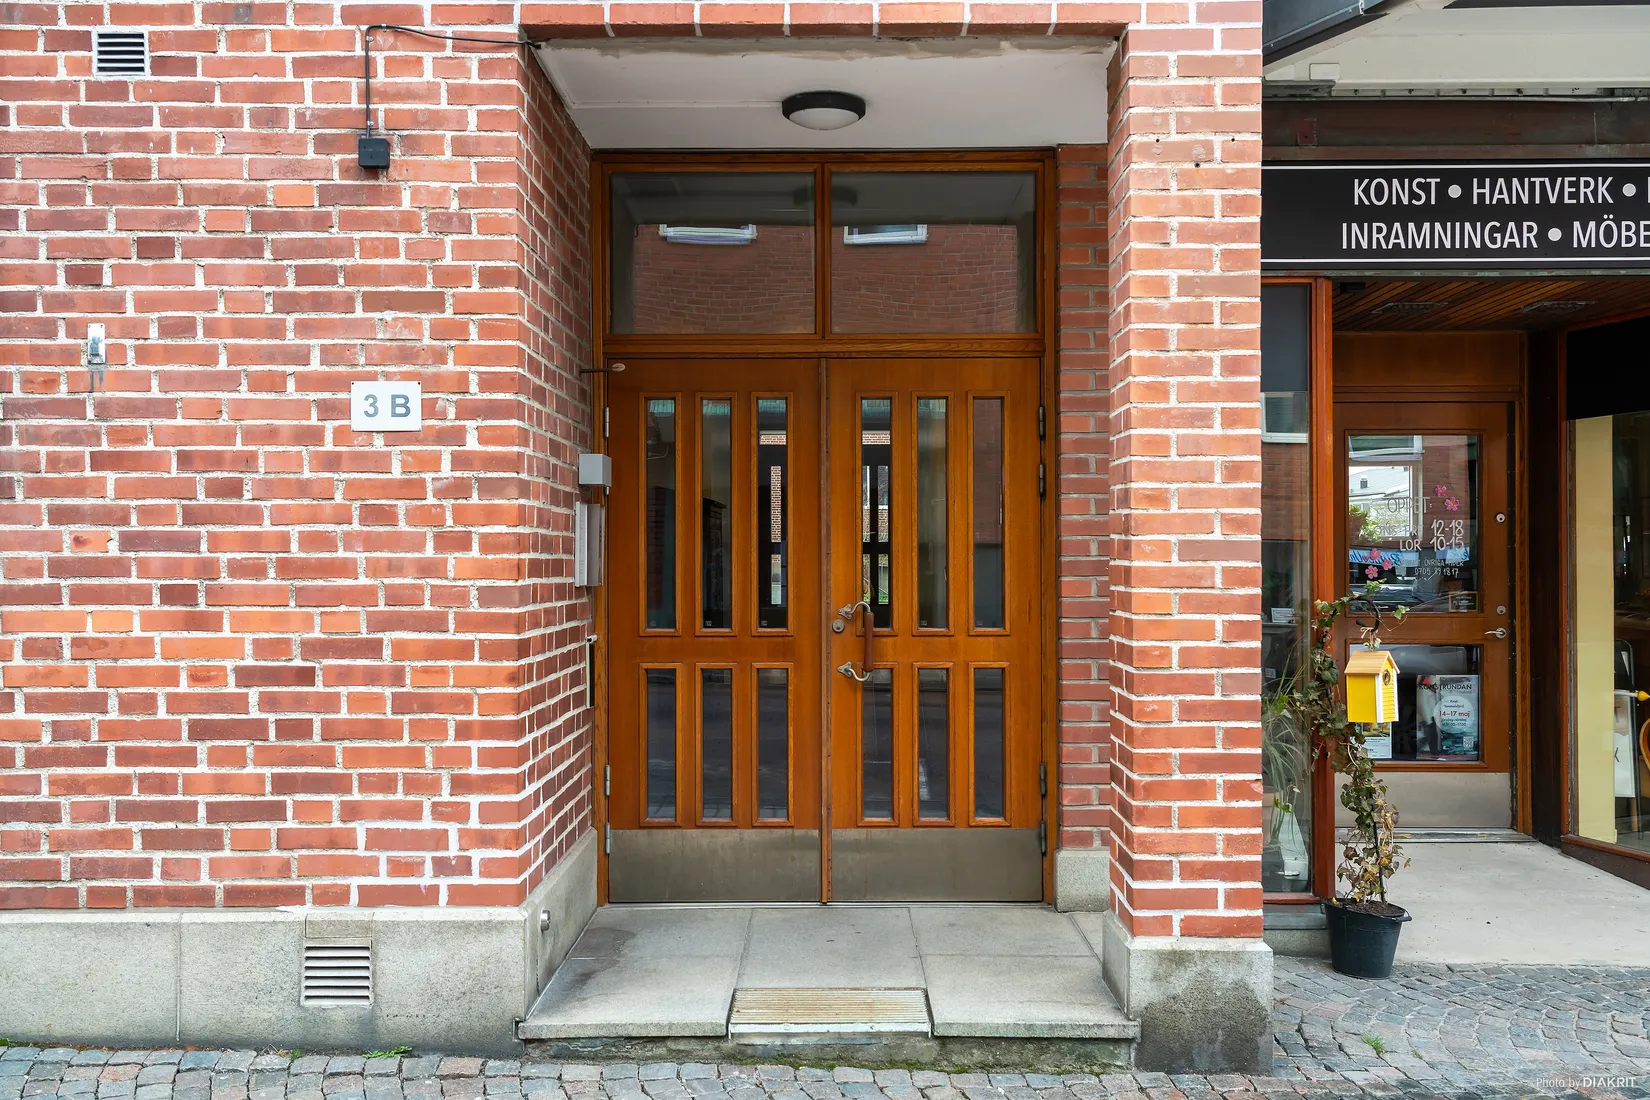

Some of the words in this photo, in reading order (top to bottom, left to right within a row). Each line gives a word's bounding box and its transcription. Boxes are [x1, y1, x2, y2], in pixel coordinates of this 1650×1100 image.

[1353, 177, 1440, 206] KONST
[1472, 176, 1614, 205] HANTVERK
[1341, 221, 1538, 249] INRAMNINGAR
[1573, 214, 1650, 249] MÖBE
[363, 393, 379, 418] 3
[390, 393, 411, 418] B
[1431, 519, 1464, 537] 12-18
[1430, 537, 1464, 551] 10-15
